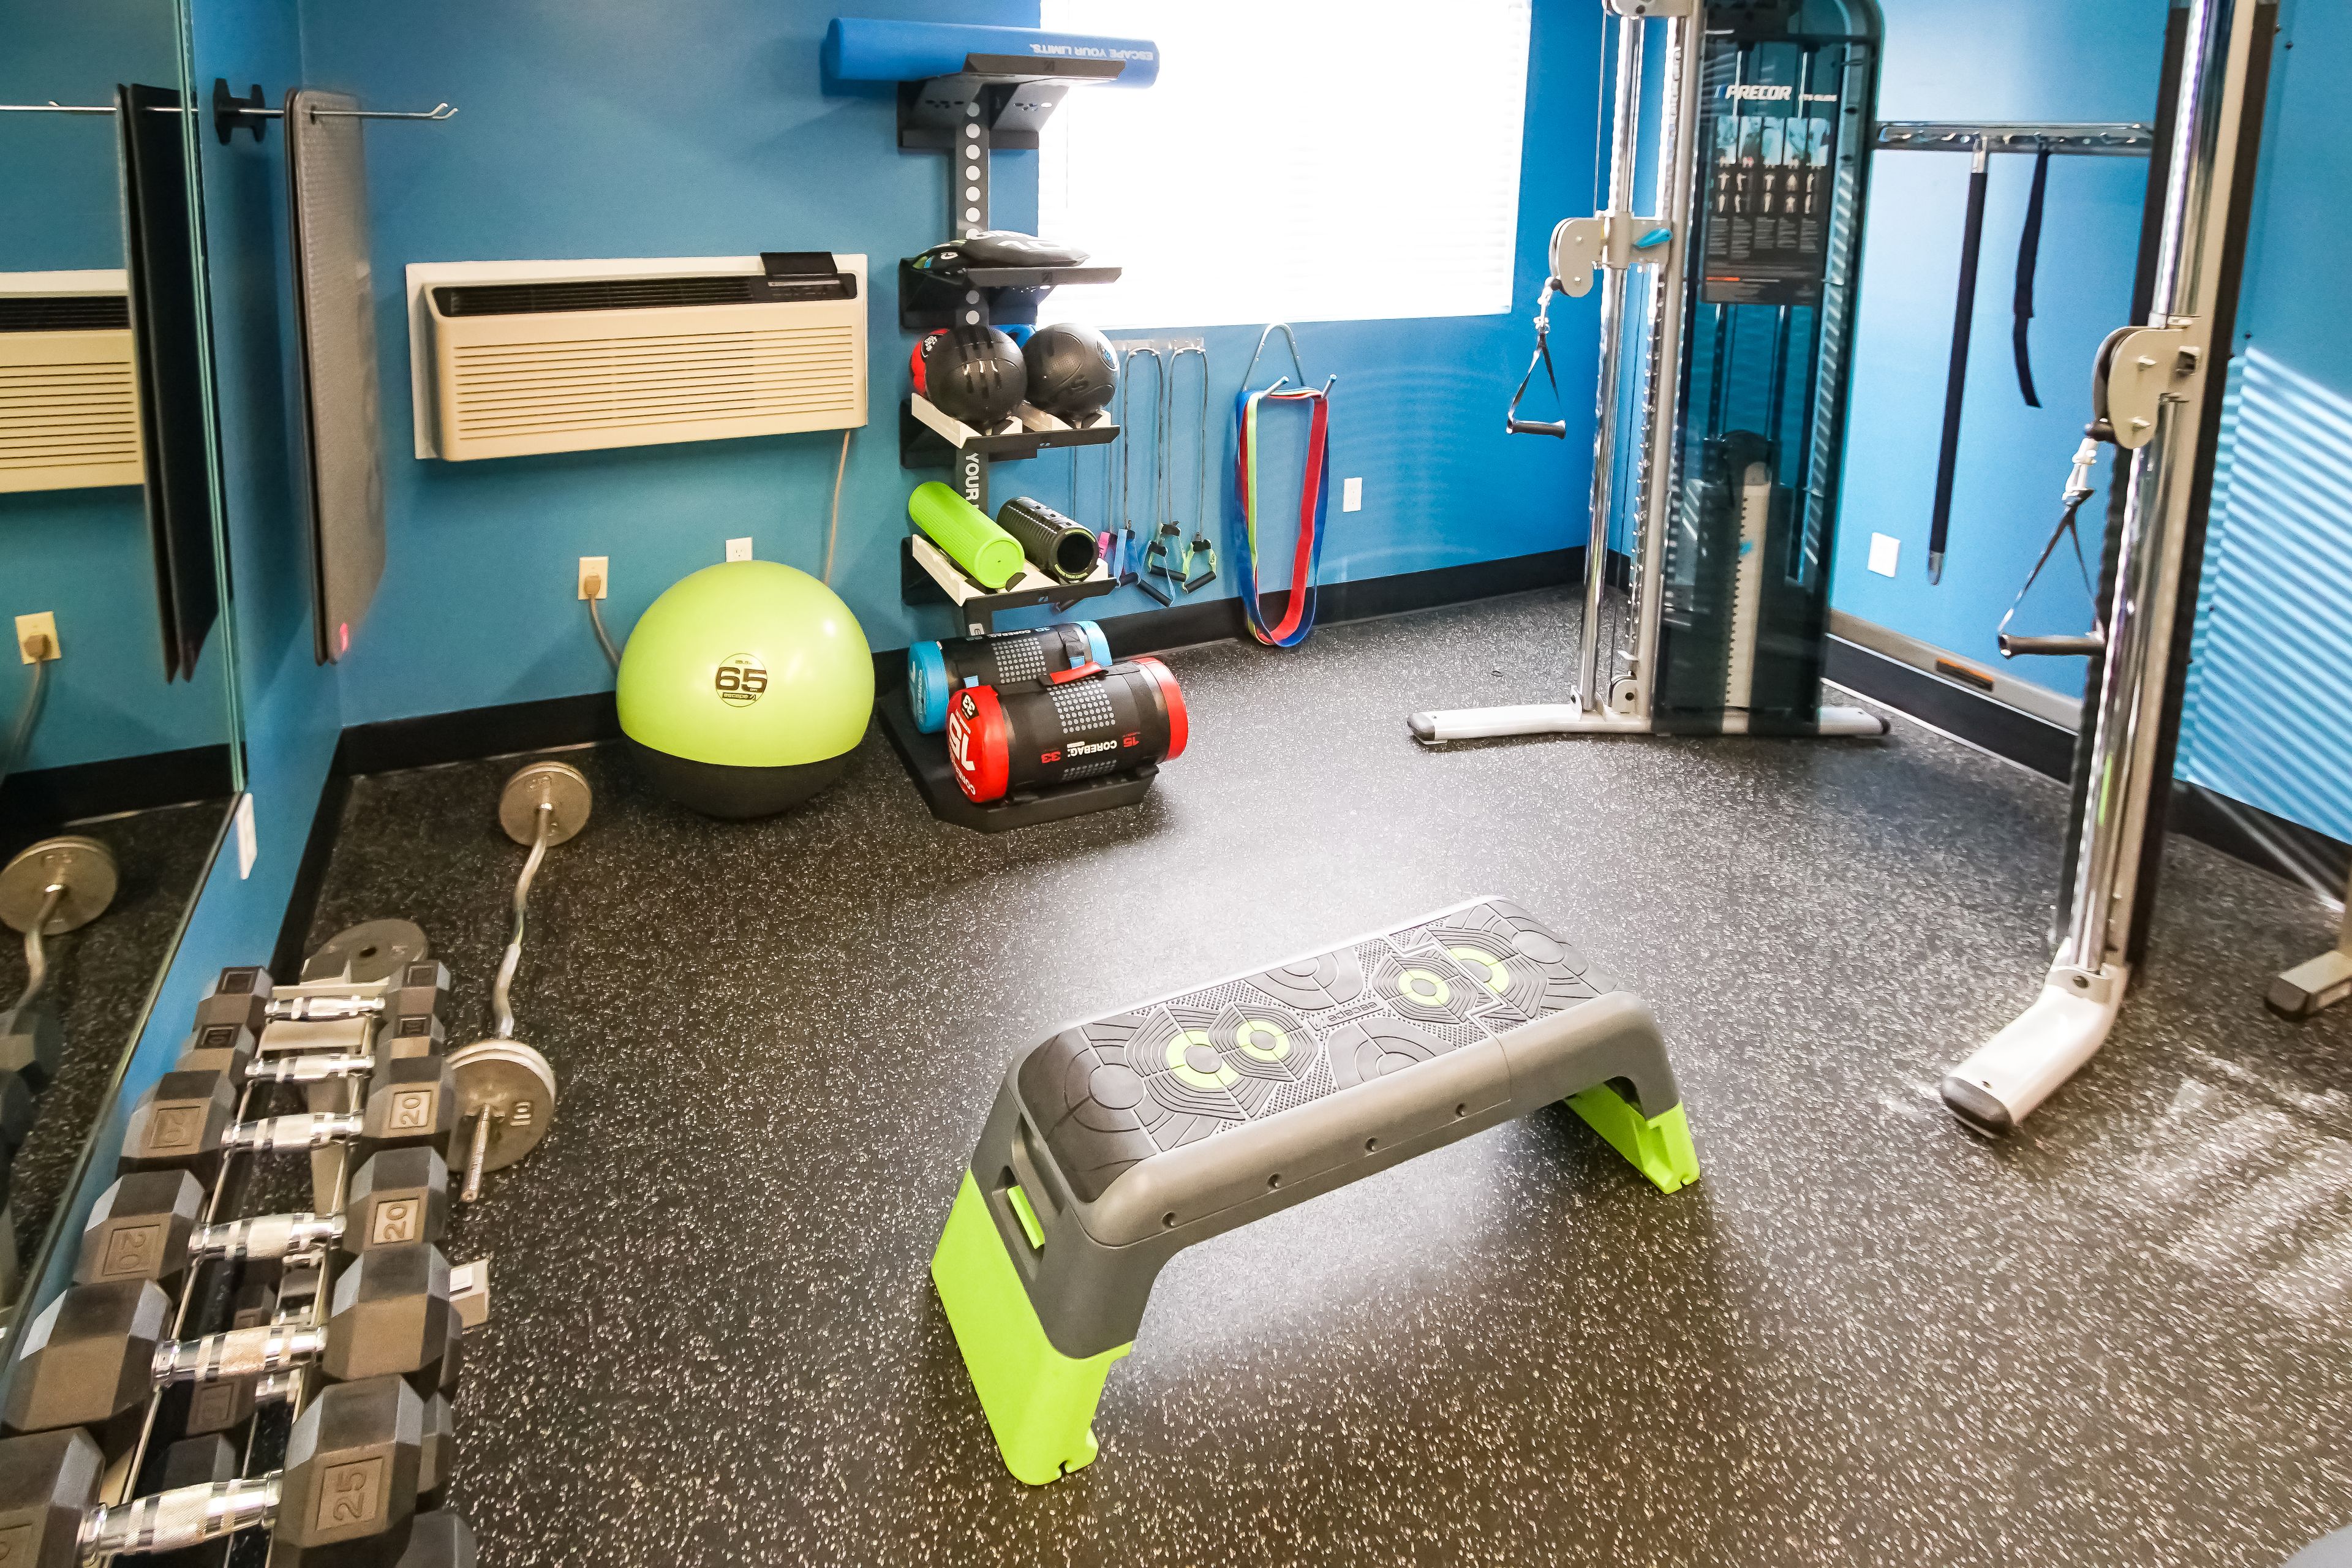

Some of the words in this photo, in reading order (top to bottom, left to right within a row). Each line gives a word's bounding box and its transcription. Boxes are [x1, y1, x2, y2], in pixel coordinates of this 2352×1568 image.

[1074, 47, 1107, 58] YOUR
[1109, 49, 1154, 61] ESCAPE
[1725, 85, 1793, 100] PRECOR
[965, 453, 979, 500] YOUR
[715, 666, 767, 693] 65
[962, 695, 975, 716] 33
[949, 712, 976, 771] 15
[1123, 736, 1139, 748] 15
[1041, 751, 1061, 764] 33
[400, 1096, 421, 1126] 20
[510, 1102, 532, 1126] 10
[383, 1202, 407, 1240] 20
[333, 1471, 366, 1521] 25
